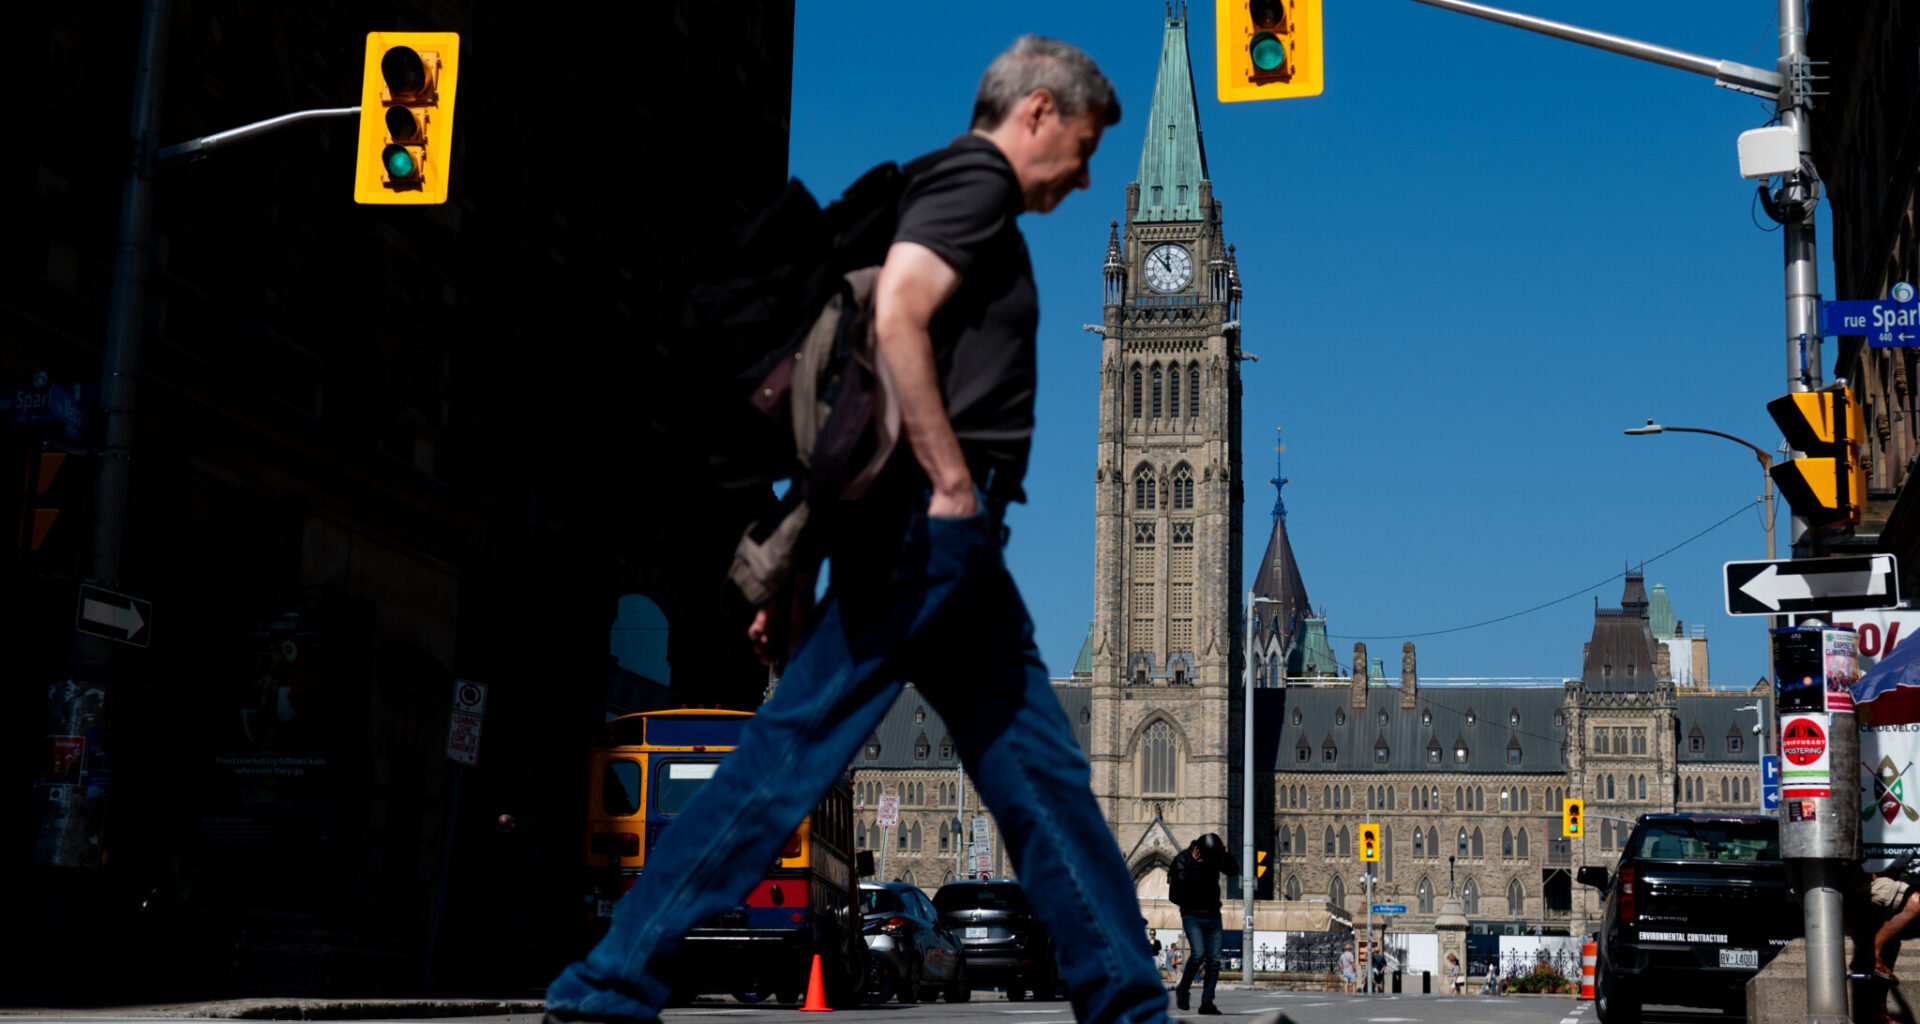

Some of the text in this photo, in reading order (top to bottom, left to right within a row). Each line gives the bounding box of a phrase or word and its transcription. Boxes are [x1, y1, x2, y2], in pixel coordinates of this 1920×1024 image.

[1844, 316, 1866, 328] rue
[1638, 931, 1728, 943] ENVIRONMENTAL CONTRACTORS
